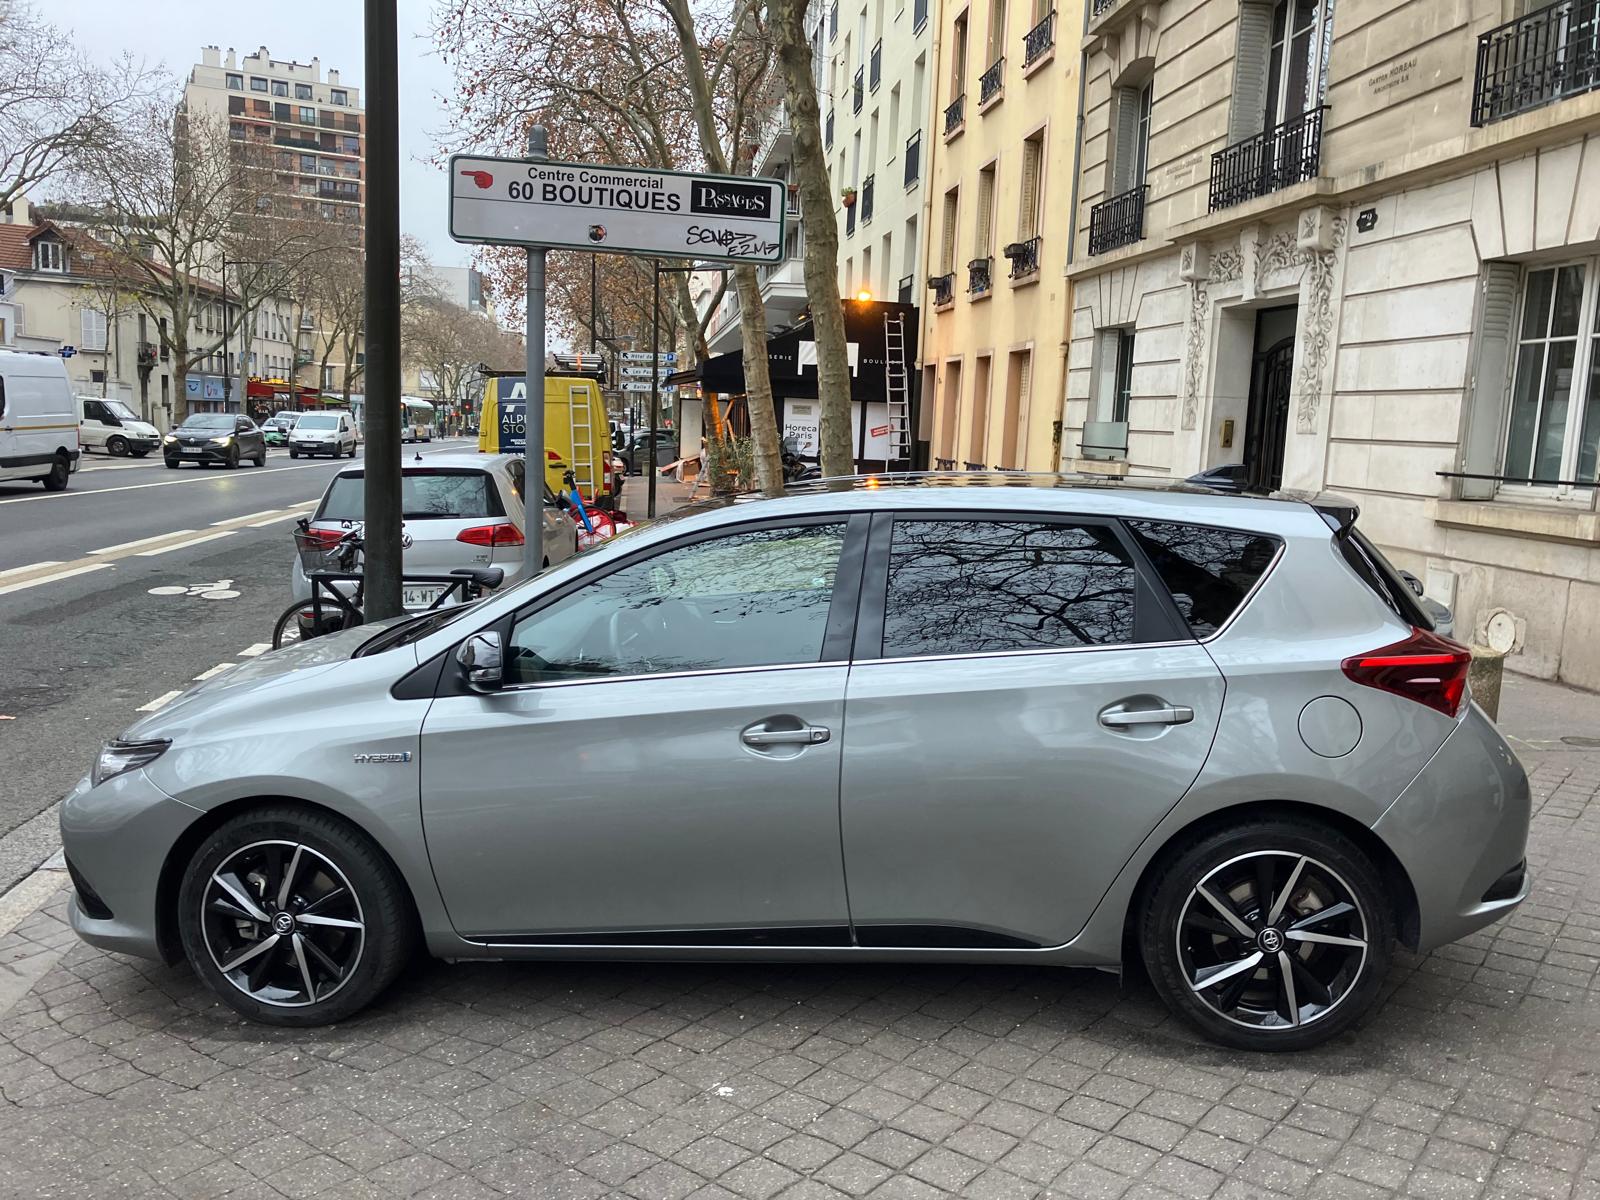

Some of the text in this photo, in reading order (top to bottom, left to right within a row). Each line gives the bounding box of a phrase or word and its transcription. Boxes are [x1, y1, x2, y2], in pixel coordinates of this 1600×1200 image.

[528, 167, 663, 189] Centre Commercial
[508, 181, 681, 212] 60 BOUTIQUES
[697, 187, 765, 211] PASSAGES
[503, 424, 526, 434] STO
[785, 424, 817, 432] Horeca
[790, 431, 813, 439] Paris
[403, 590, 434, 603] 14-WT
